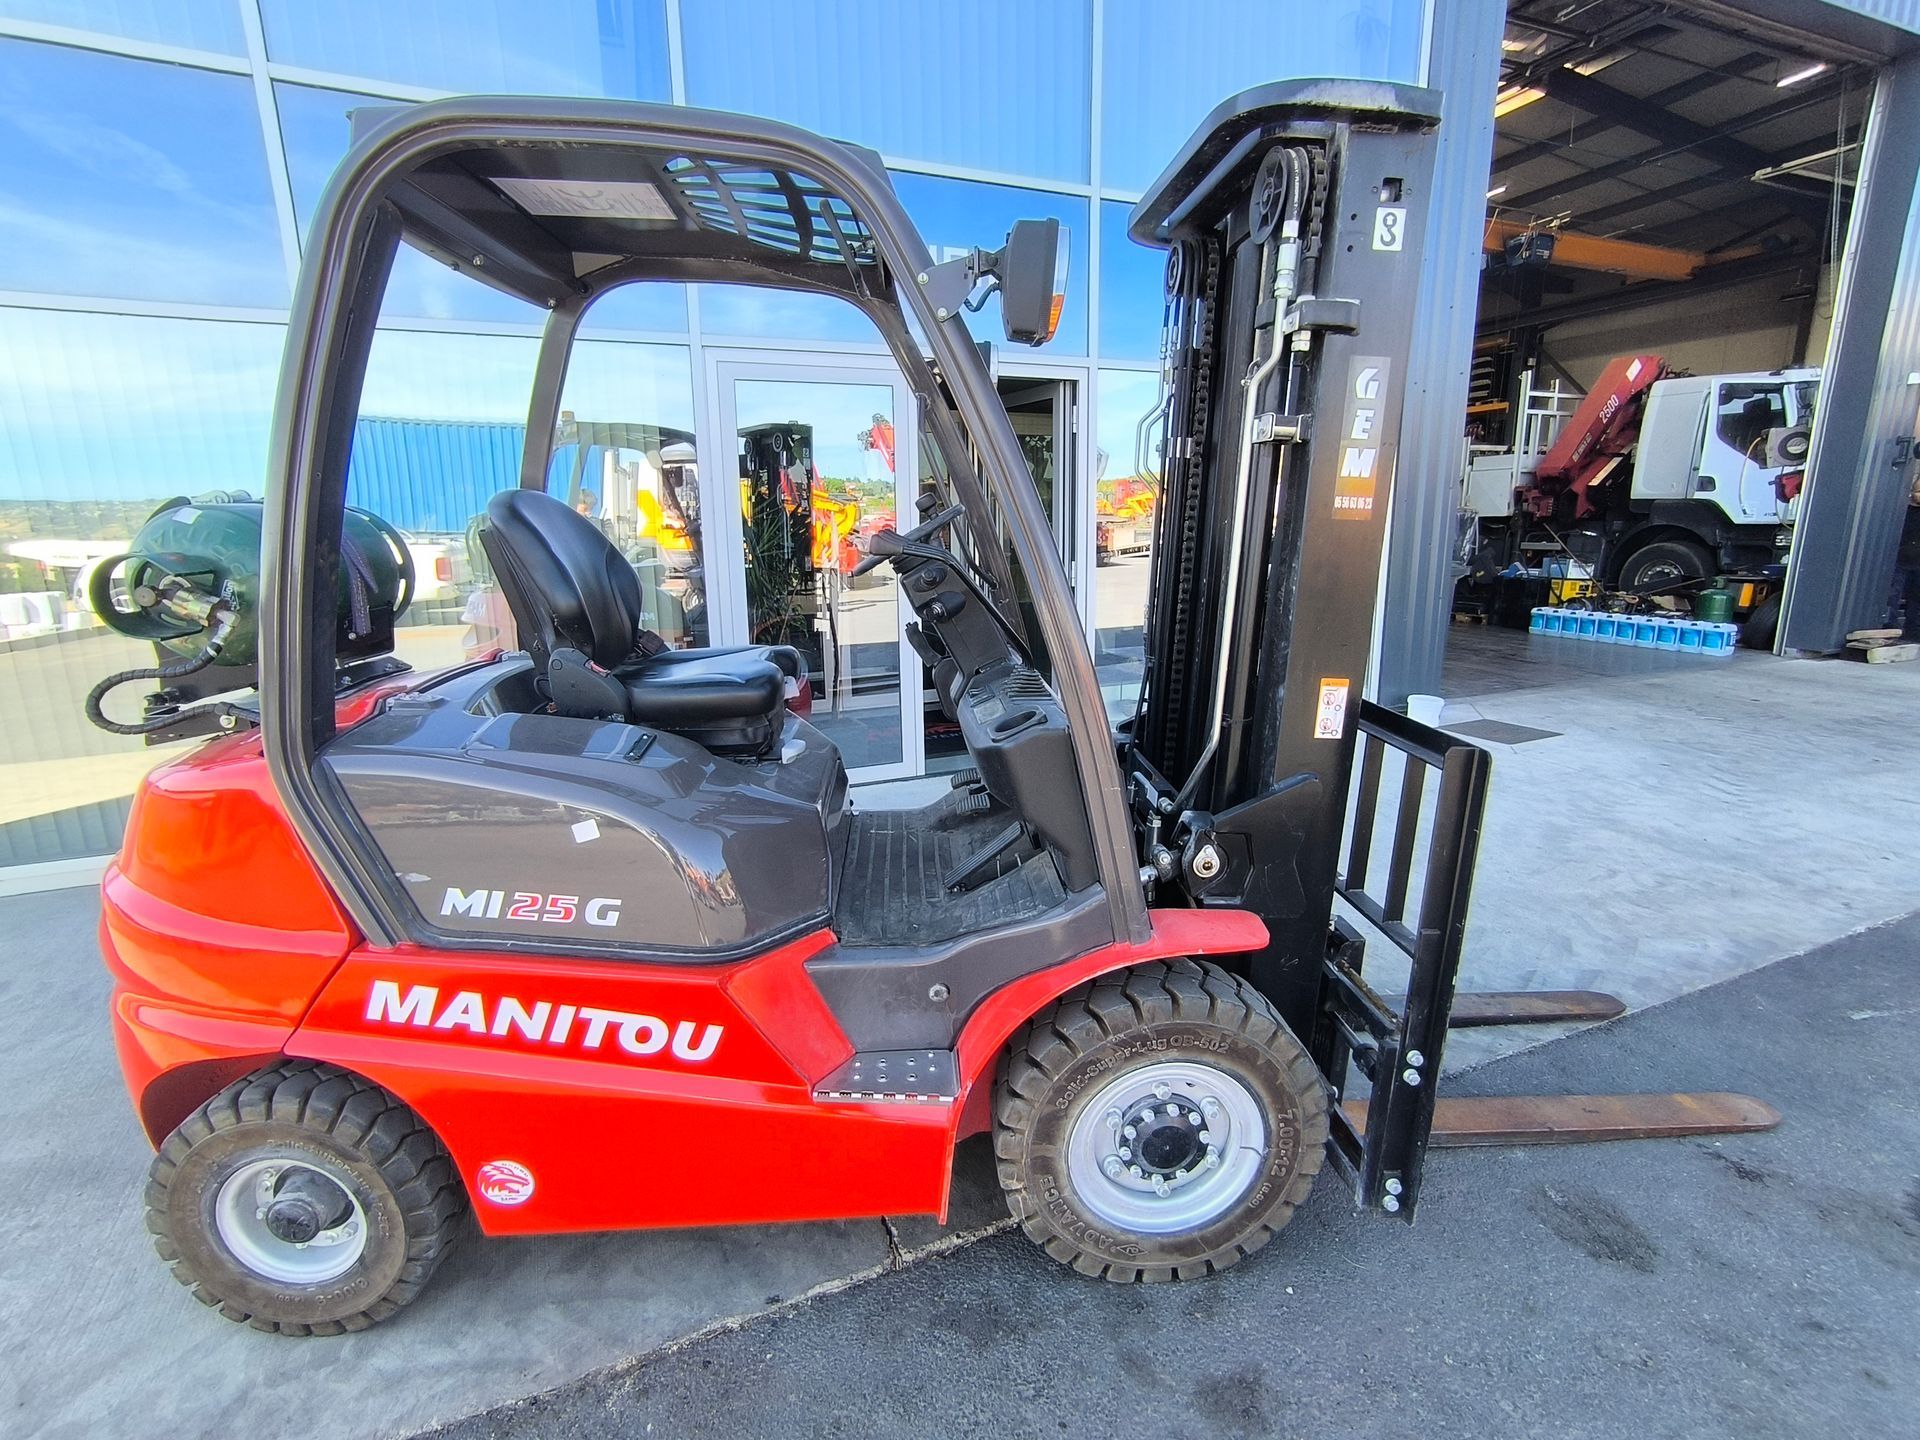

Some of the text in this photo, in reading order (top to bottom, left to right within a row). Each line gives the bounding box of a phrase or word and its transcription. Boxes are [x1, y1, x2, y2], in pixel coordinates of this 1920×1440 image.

[1340, 367, 1380, 478] GEM
[1599, 394, 1620, 424] 2500
[1334, 495, 1342, 509] 05
[1350, 497, 1357, 509] 63
[1365, 498, 1373, 510] 23
[365, 980, 725, 1061] MANITOU
[1271, 1109, 1294, 1177] 7.00-12
[1040, 1175, 1114, 1250] ADVANCE
